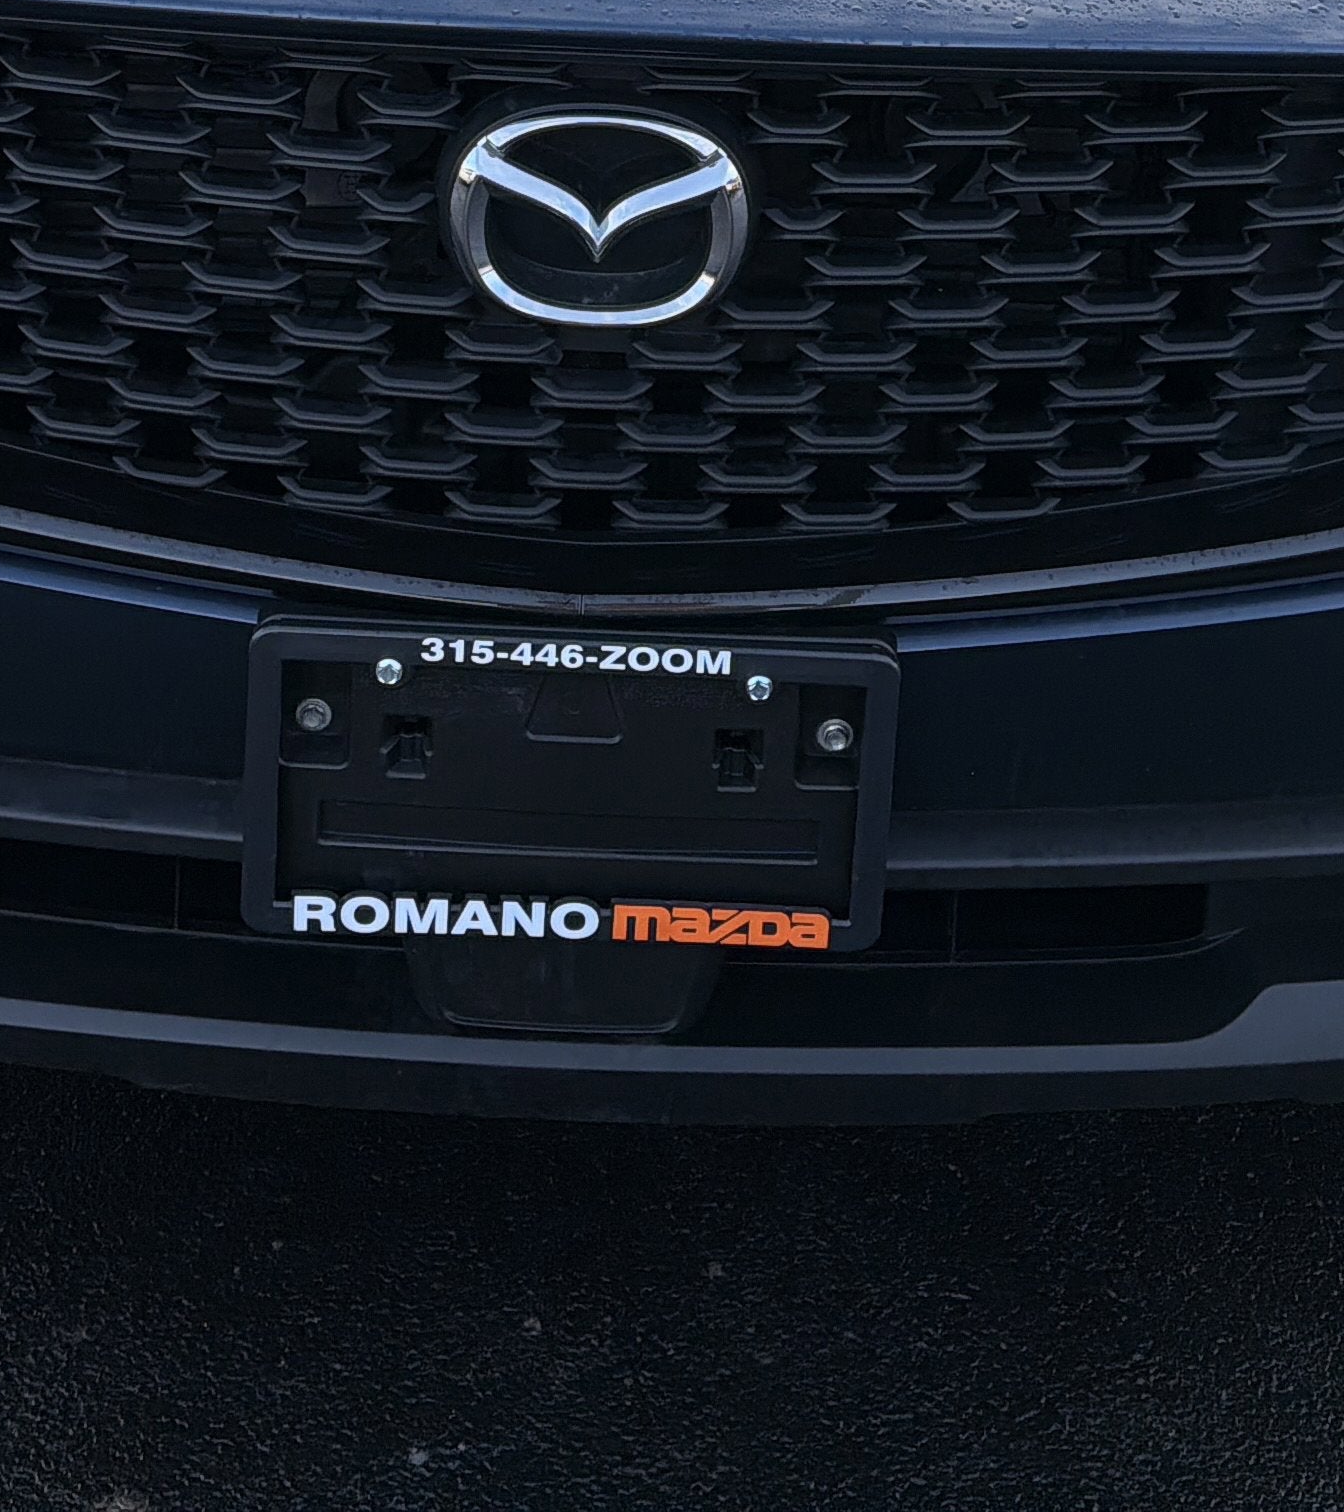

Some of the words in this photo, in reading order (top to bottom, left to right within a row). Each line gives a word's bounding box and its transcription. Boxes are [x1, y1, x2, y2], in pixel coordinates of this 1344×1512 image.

[420, 637, 733, 675] 315-446-ZOOM
[292, 895, 600, 939] ROMANO
[611, 904, 831, 949] mazda
